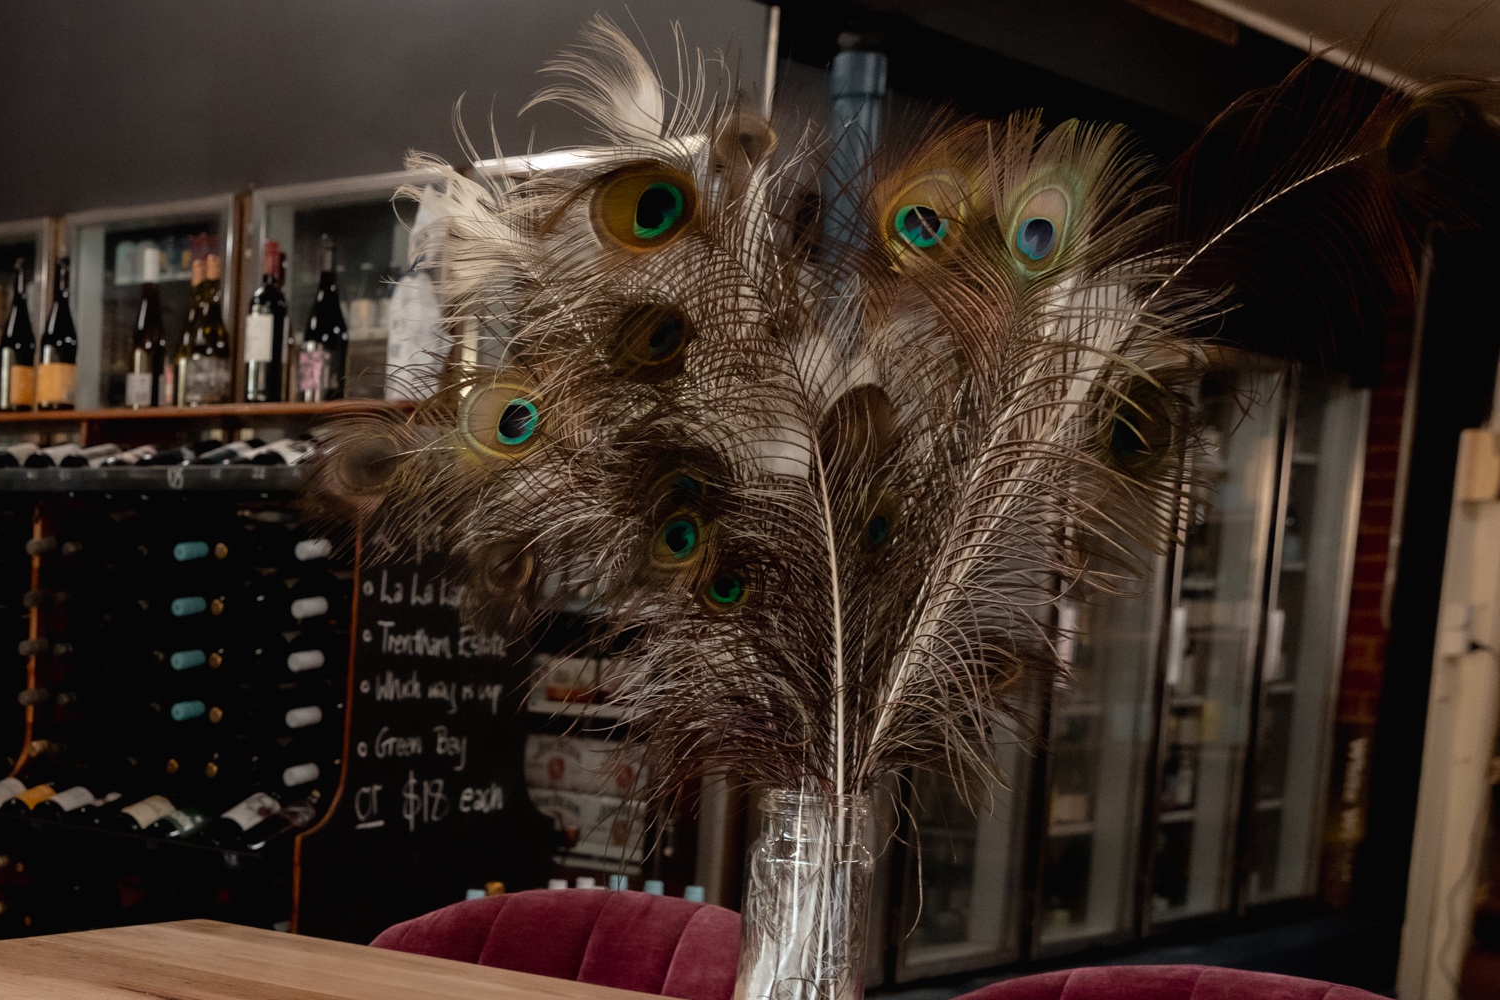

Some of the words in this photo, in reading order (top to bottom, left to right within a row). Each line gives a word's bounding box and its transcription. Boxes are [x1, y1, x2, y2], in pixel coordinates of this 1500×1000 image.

[379, 568, 404, 605] La
[410, 572, 435, 606] La
[375, 669, 422, 701] Which
[427, 680, 458, 715] way
[477, 684, 504, 716] up
[374, 726, 423, 759] Green
[432, 725, 468, 771] Bay
[401, 769, 449, 833] $18
[458, 782, 504, 814] each
